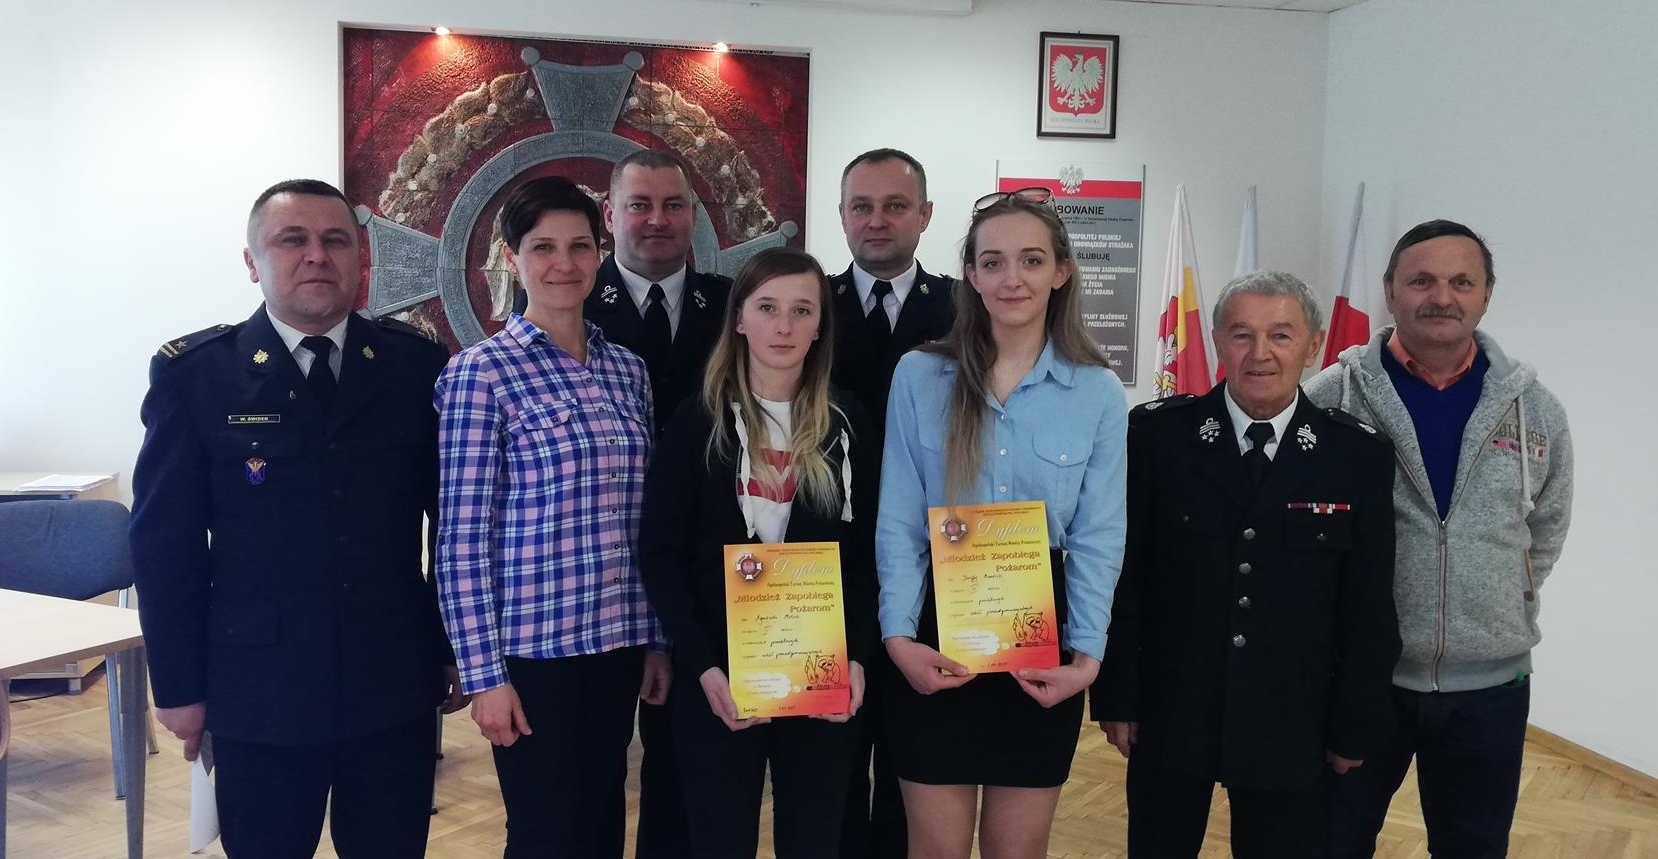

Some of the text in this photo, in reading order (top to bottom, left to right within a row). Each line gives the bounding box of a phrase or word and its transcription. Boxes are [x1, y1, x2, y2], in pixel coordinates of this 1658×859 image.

[1055, 205, 1104, 215] BOWANIE
[1076, 252, 1110, 261] ŚLUBUJĘ
[977, 519, 1039, 540] Dyplom
[991, 551, 1041, 561] Zapobiega
[772, 559, 834, 580] Dyplom
[785, 591, 834, 602] Zapobiega
